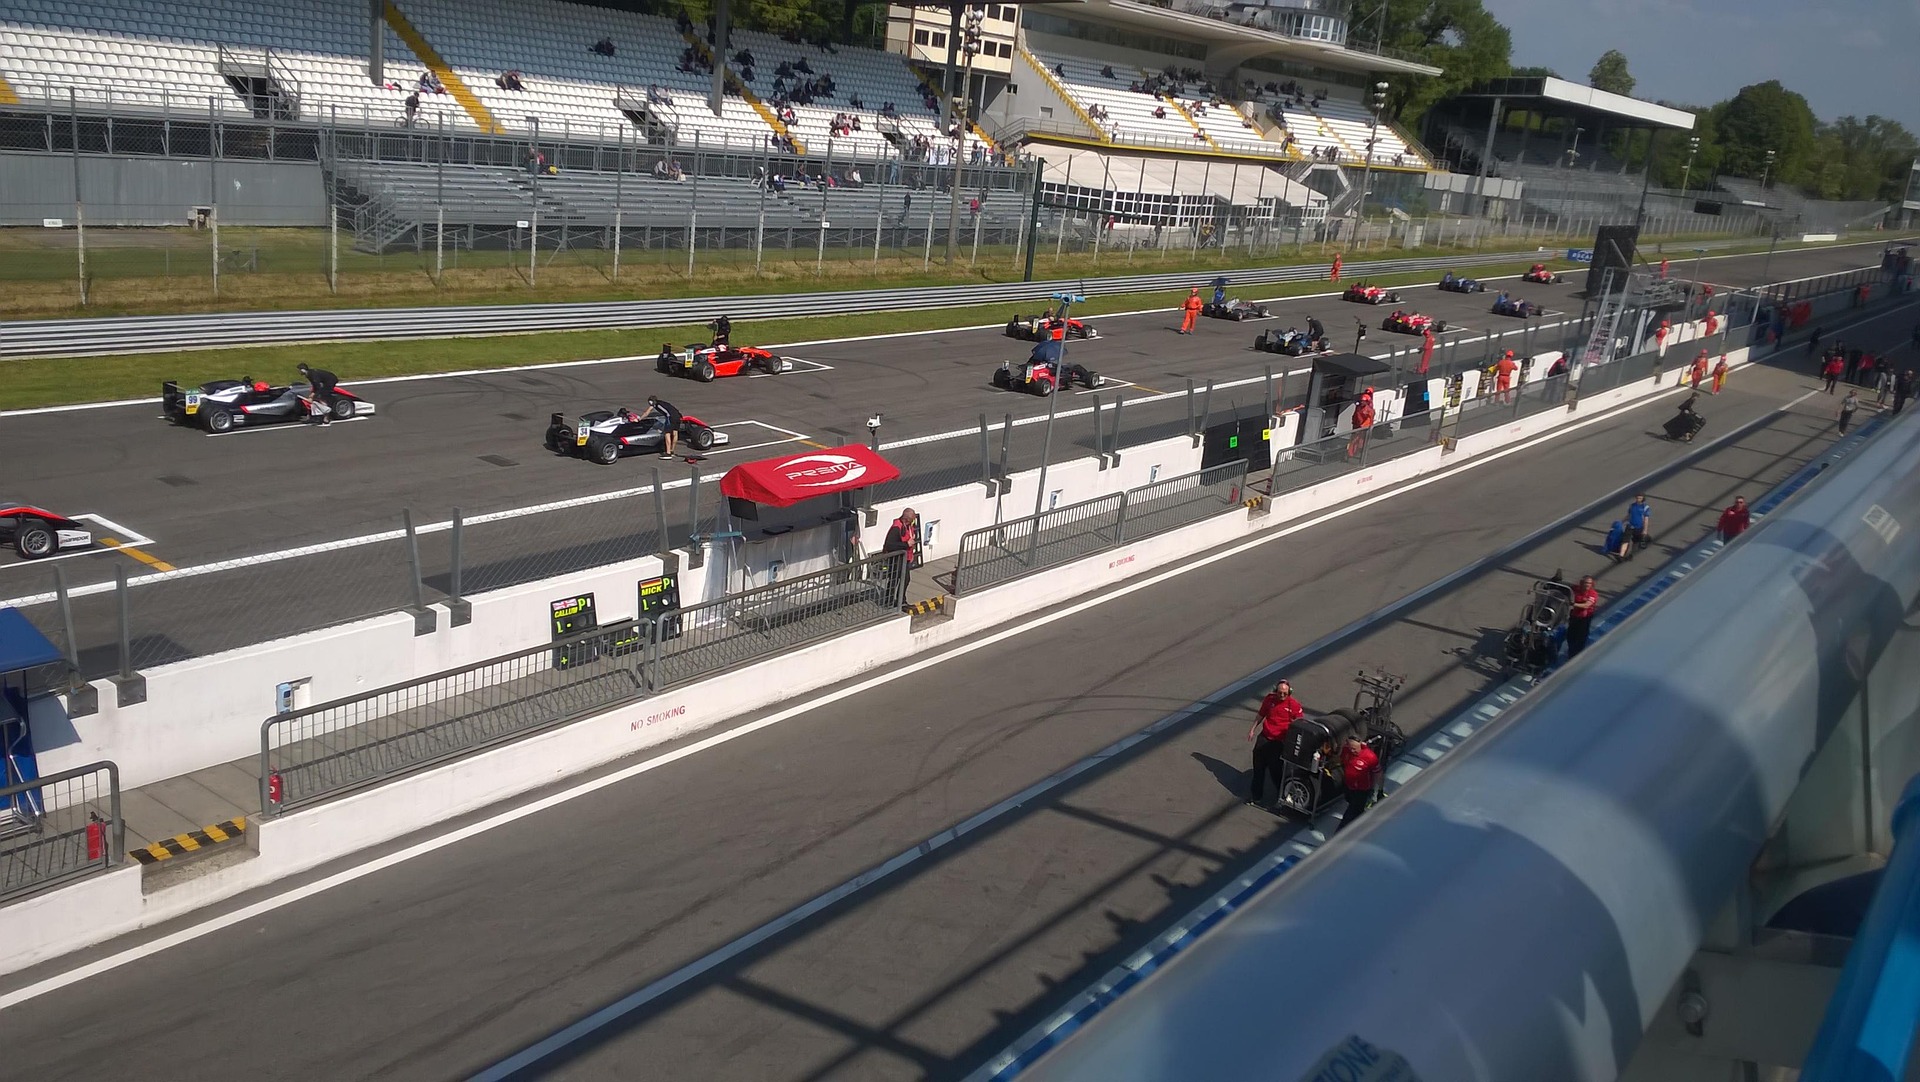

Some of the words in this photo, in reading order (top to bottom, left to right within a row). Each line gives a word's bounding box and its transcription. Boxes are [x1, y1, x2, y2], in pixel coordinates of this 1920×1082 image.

[785, 461, 863, 480] PREMA
[641, 585, 663, 597] MICK
[554, 606, 579, 619] CALLUM
[630, 719, 644, 732] NO
[646, 705, 686, 726] SMOKING
